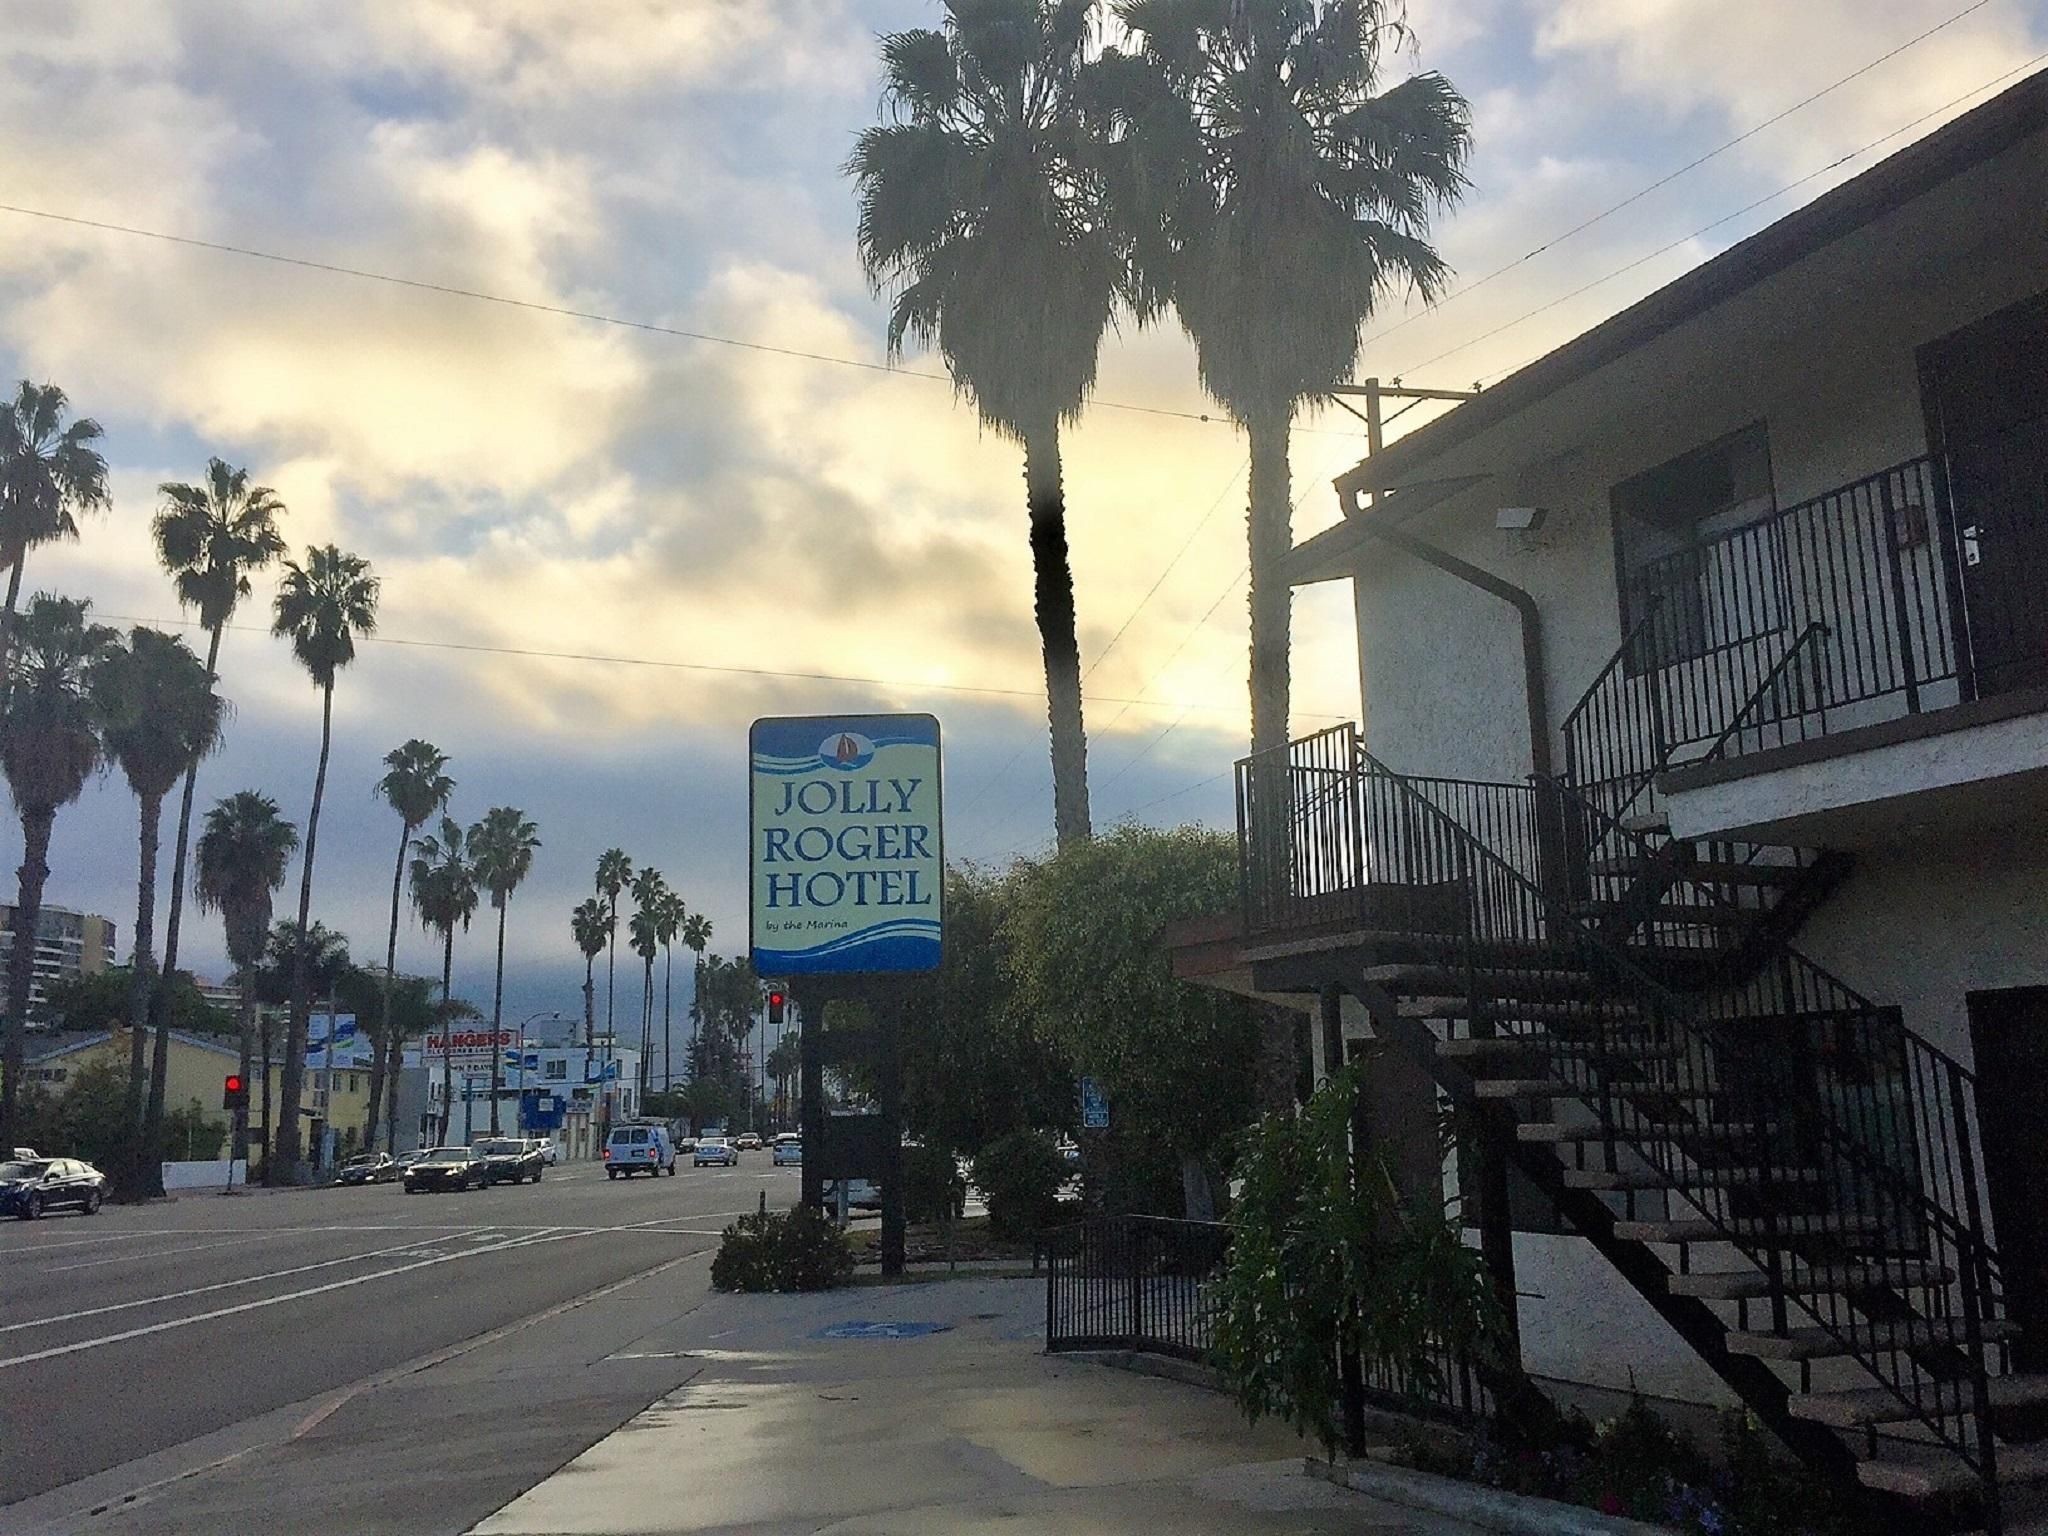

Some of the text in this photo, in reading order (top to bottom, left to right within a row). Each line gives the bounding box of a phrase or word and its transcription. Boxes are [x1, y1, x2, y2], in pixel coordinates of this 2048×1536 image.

[774, 778, 922, 816] JOLLY
[763, 824, 933, 862] ROGER
[765, 870, 932, 908] HOTEL
[766, 919, 848, 933] by the Marina
